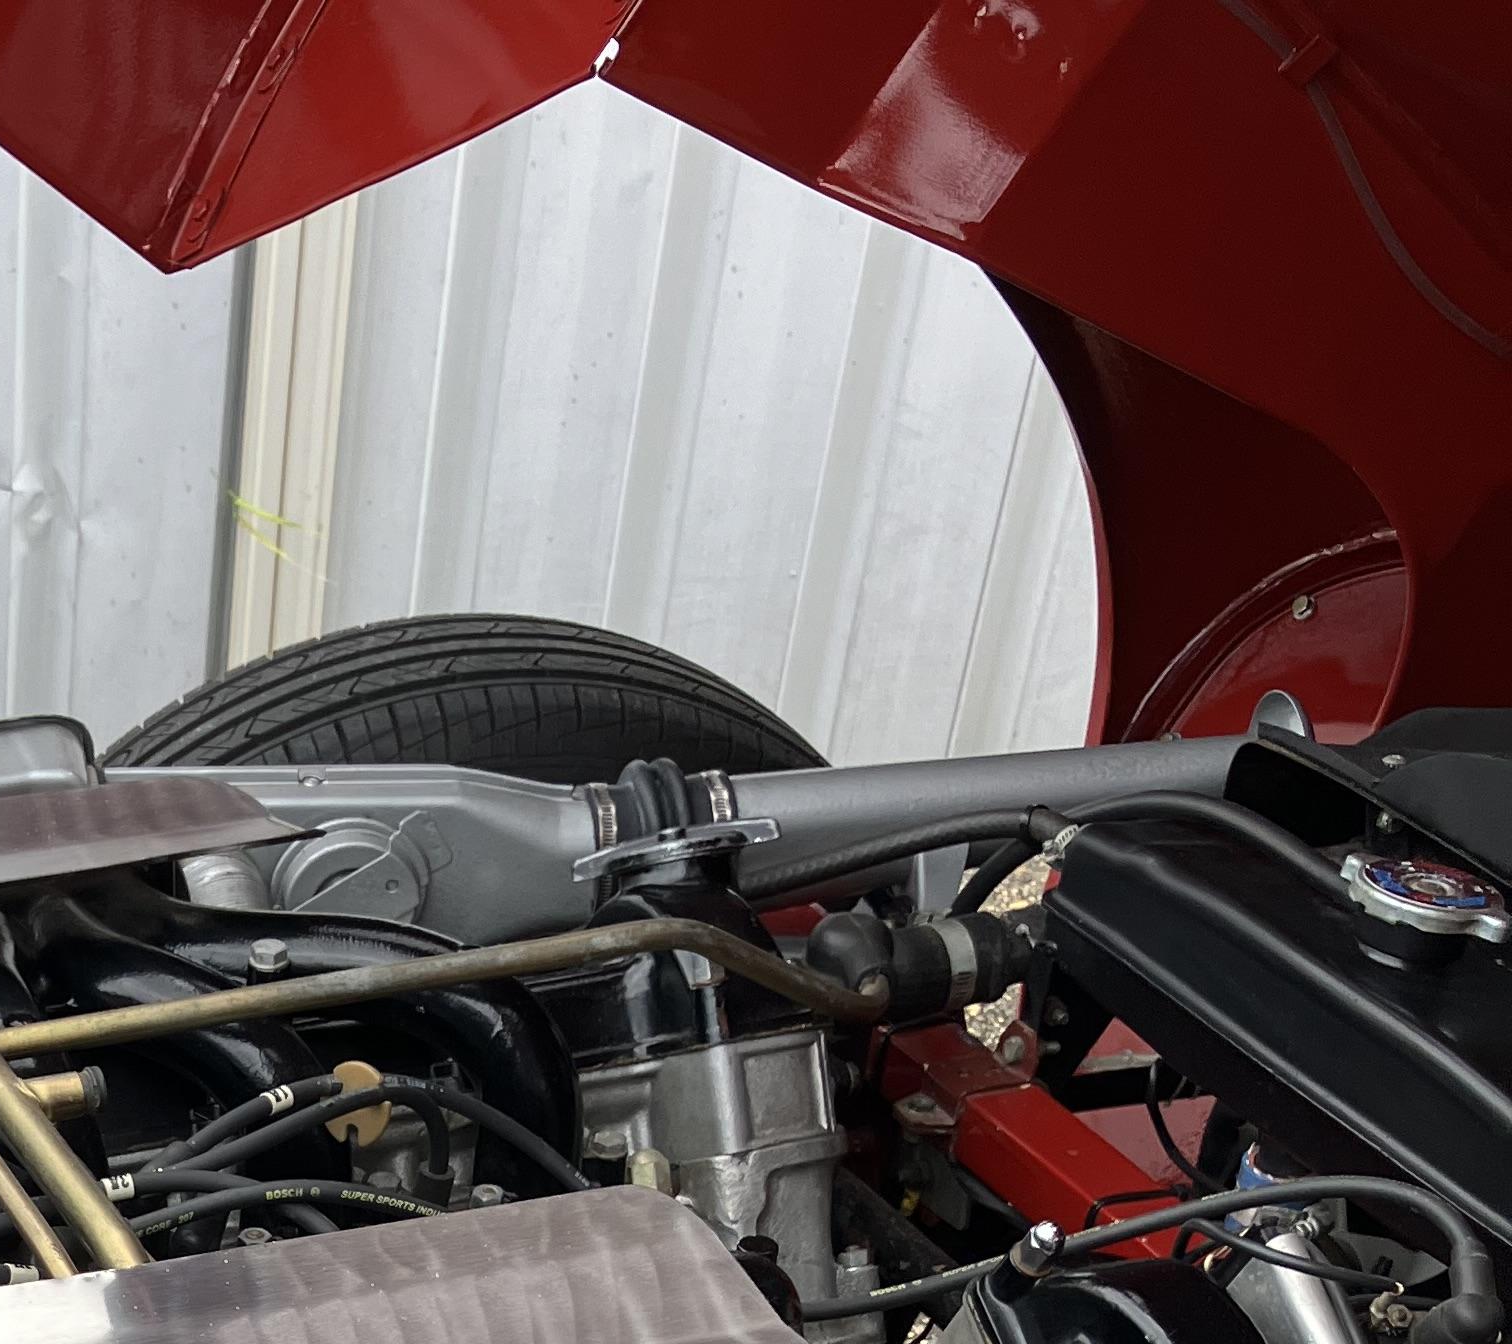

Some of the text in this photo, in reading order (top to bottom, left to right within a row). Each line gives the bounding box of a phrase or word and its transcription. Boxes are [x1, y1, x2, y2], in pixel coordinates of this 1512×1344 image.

[265, 1187, 448, 1218] BOSCH SUPER SPORTS INDU
